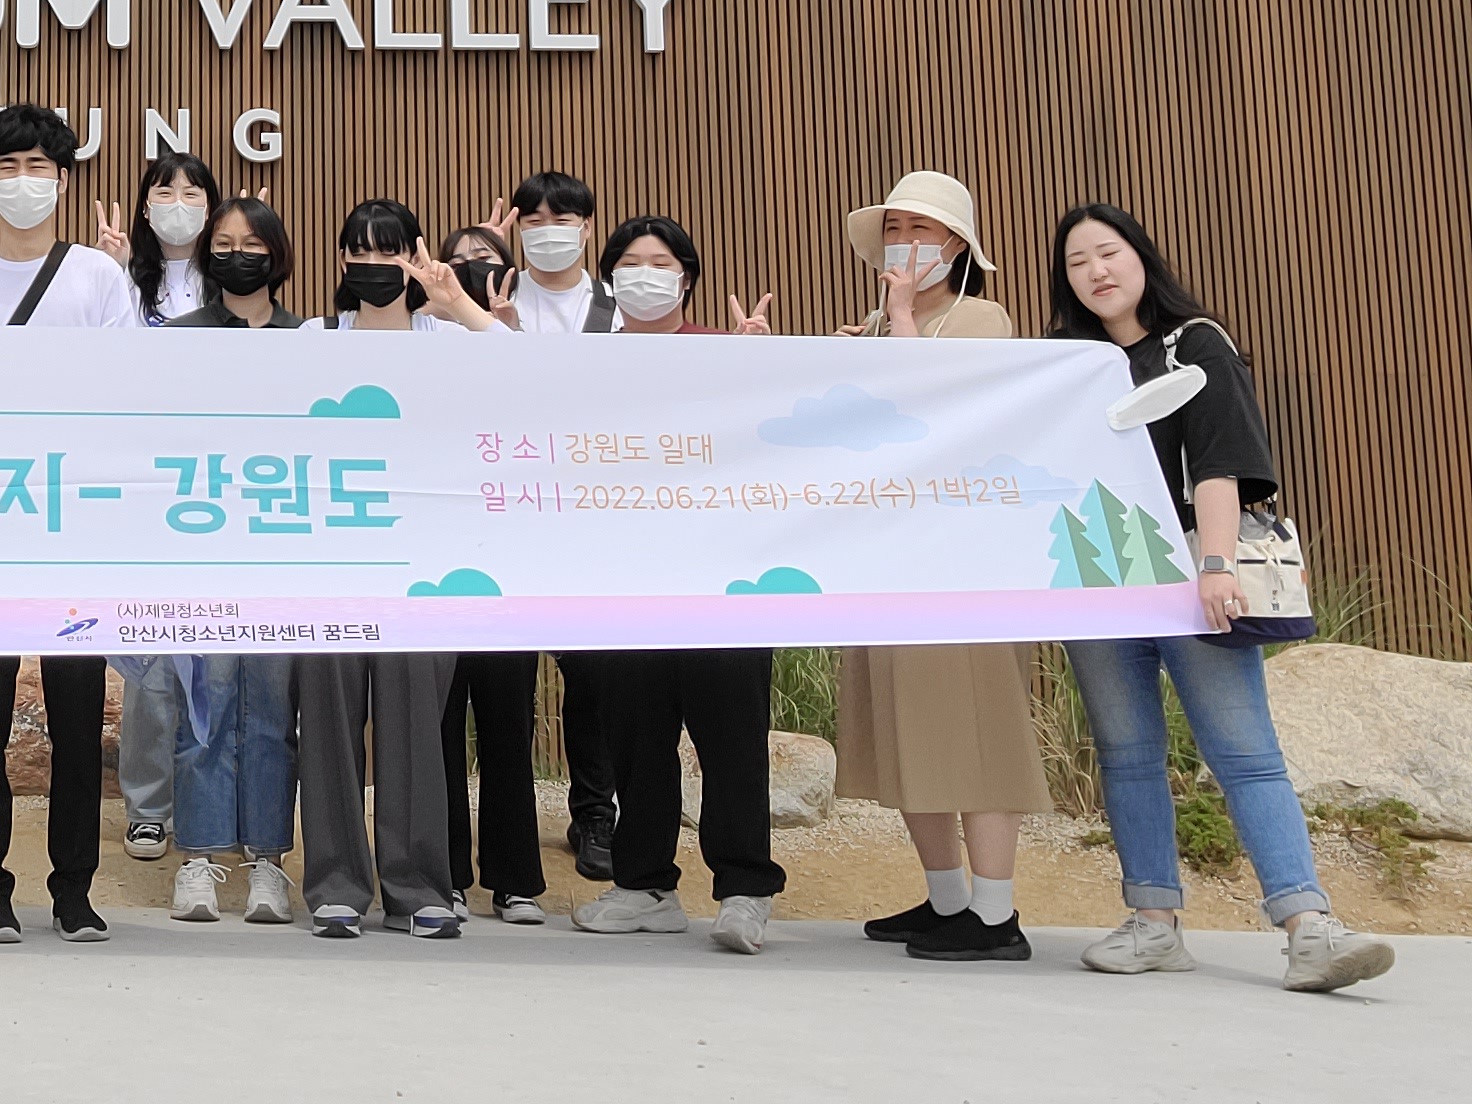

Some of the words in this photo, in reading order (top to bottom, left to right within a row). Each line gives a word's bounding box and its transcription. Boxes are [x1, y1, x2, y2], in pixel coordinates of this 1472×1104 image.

[564, 433, 651, 465] 강원도
[658, 433, 714, 465] 일대
[153, 453, 403, 535] 강원도
[925, 475, 1023, 507] 1박2일
[117, 602, 240, 620] (사)제일청소년회
[118, 623, 316, 644] 안산시청소년지원센터
[321, 623, 381, 642] 꿈드림
